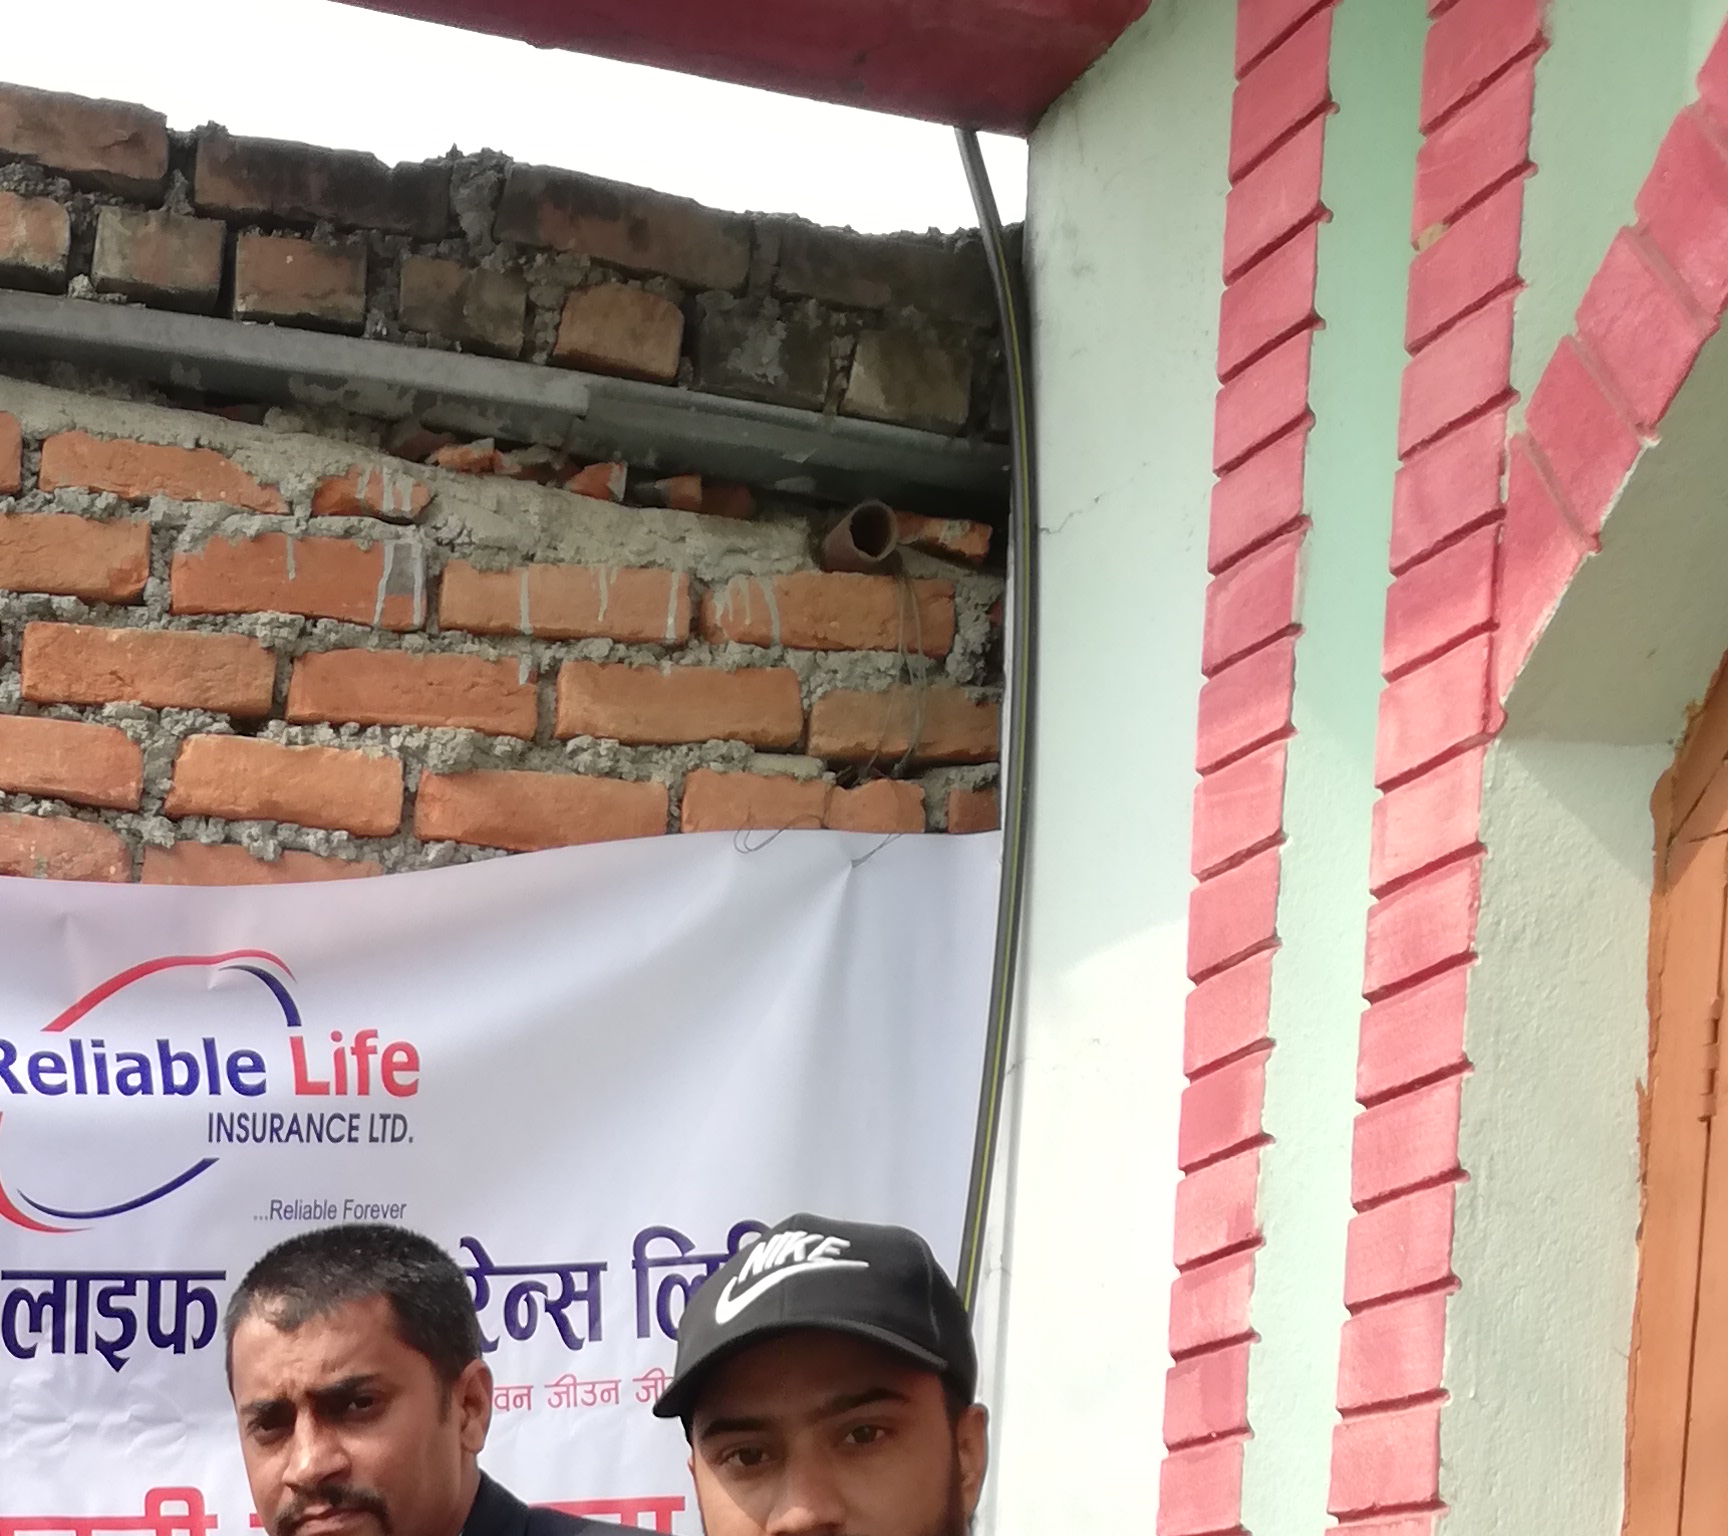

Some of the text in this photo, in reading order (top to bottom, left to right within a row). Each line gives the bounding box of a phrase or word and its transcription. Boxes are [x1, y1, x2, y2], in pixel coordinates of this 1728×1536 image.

[289, 1029, 420, 1098] Life
[207, 1111, 413, 1144] INSURANCE LTD.
[342, 1199, 407, 1221] Forever
[737, 1230, 851, 1284] NIKE
[0, 1269, 227, 1373] लाइफ
[493, 1383, 534, 1412] वन
